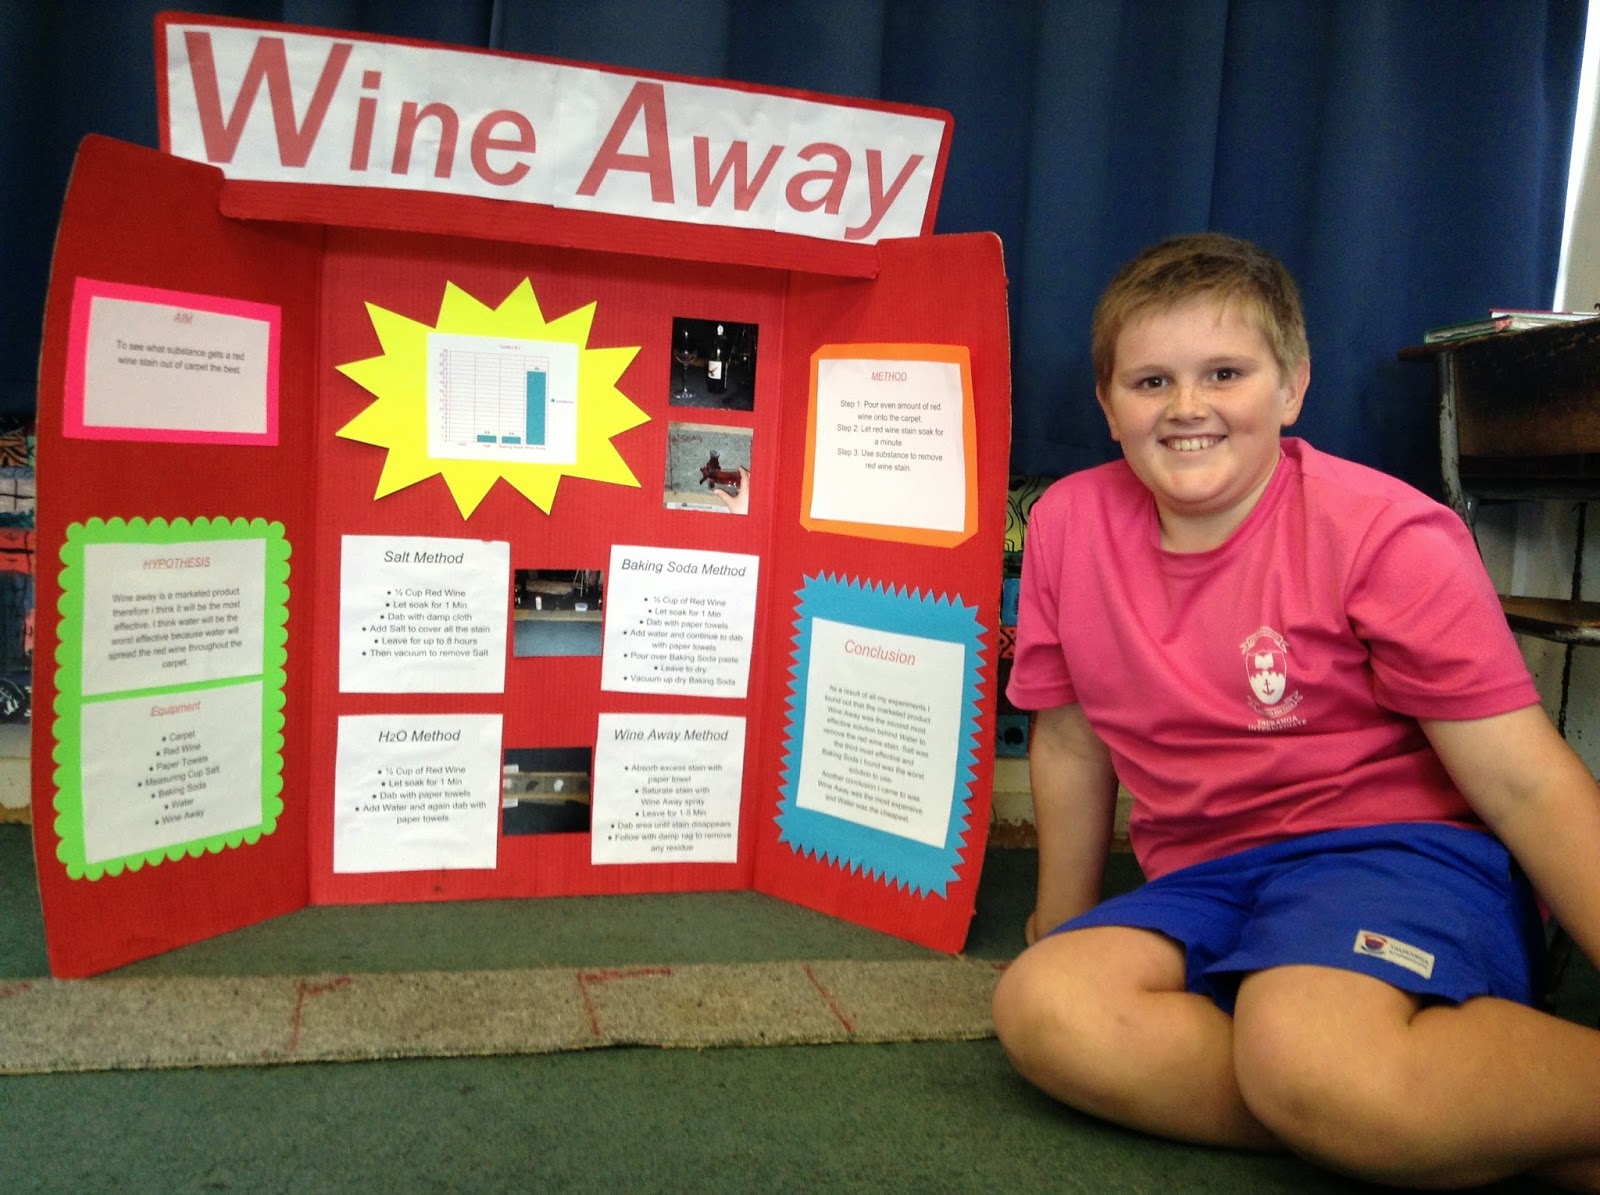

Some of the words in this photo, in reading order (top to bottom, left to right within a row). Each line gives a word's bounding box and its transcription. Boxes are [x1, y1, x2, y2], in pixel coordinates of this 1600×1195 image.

[183, 29, 539, 186] Wine
[575, 81, 925, 241] Away
[871, 372, 908, 382] METHOD
[840, 400, 855, 409] Step
[863, 401, 879, 409] Pour
[874, 414, 888, 422] onto
[837, 424, 852, 433] Step
[861, 425, 872, 433] Let
[885, 426, 900, 434] wine
[901, 427, 917, 435] stain
[837, 448, 852, 456] Step
[861, 449, 874, 457] Use
[875, 450, 909, 460] substance
[865, 462, 876, 470] red
[877, 463, 893, 471] wine
[143, 556, 211, 569] HYPOTHESIS
[384, 551, 410, 563] Salt
[414, 551, 464, 564] Method
[621, 559, 663, 574] Baking
[667, 562, 698, 574] Soda
[701, 564, 746, 577] Method
[405, 589, 423, 598] Cup
[409, 601, 429, 609] soak
[662, 596, 678, 605] Cup
[689, 597, 705, 606] Red
[707, 599, 726, 607] Wine
[426, 613, 450, 622] damp
[681, 621, 703, 629] paper
[844, 639, 916, 666] Conclusion
[151, 701, 201, 717] Equipment
[169, 731, 195, 742] Carpet
[411, 730, 461, 741] Method
[614, 729, 644, 740] Wine
[647, 729, 681, 743] Away
[684, 730, 729, 741] Method
[163, 747, 180, 755] Red
[182, 744, 201, 753] Wine
[156, 761, 180, 771] Paper
[182, 755, 208, 766] Towels
[145, 772, 186, 786] Measuring
[188, 768, 204, 779] Cup
[205, 766, 220, 775] Salt
[396, 767, 413, 776] Cup
[445, 766, 466, 774] Wine
[158, 788, 185, 798] Baking
[187, 782, 207, 792] Soda
[399, 791, 417, 799] with
[418, 791, 443, 800] paper
[445, 790, 471, 798] towels
[171, 799, 194, 808] Water
[428, 803, 450, 812] again
[162, 815, 182, 824] Wine
[184, 810, 205, 820] Away
[396, 815, 421, 824] paper
